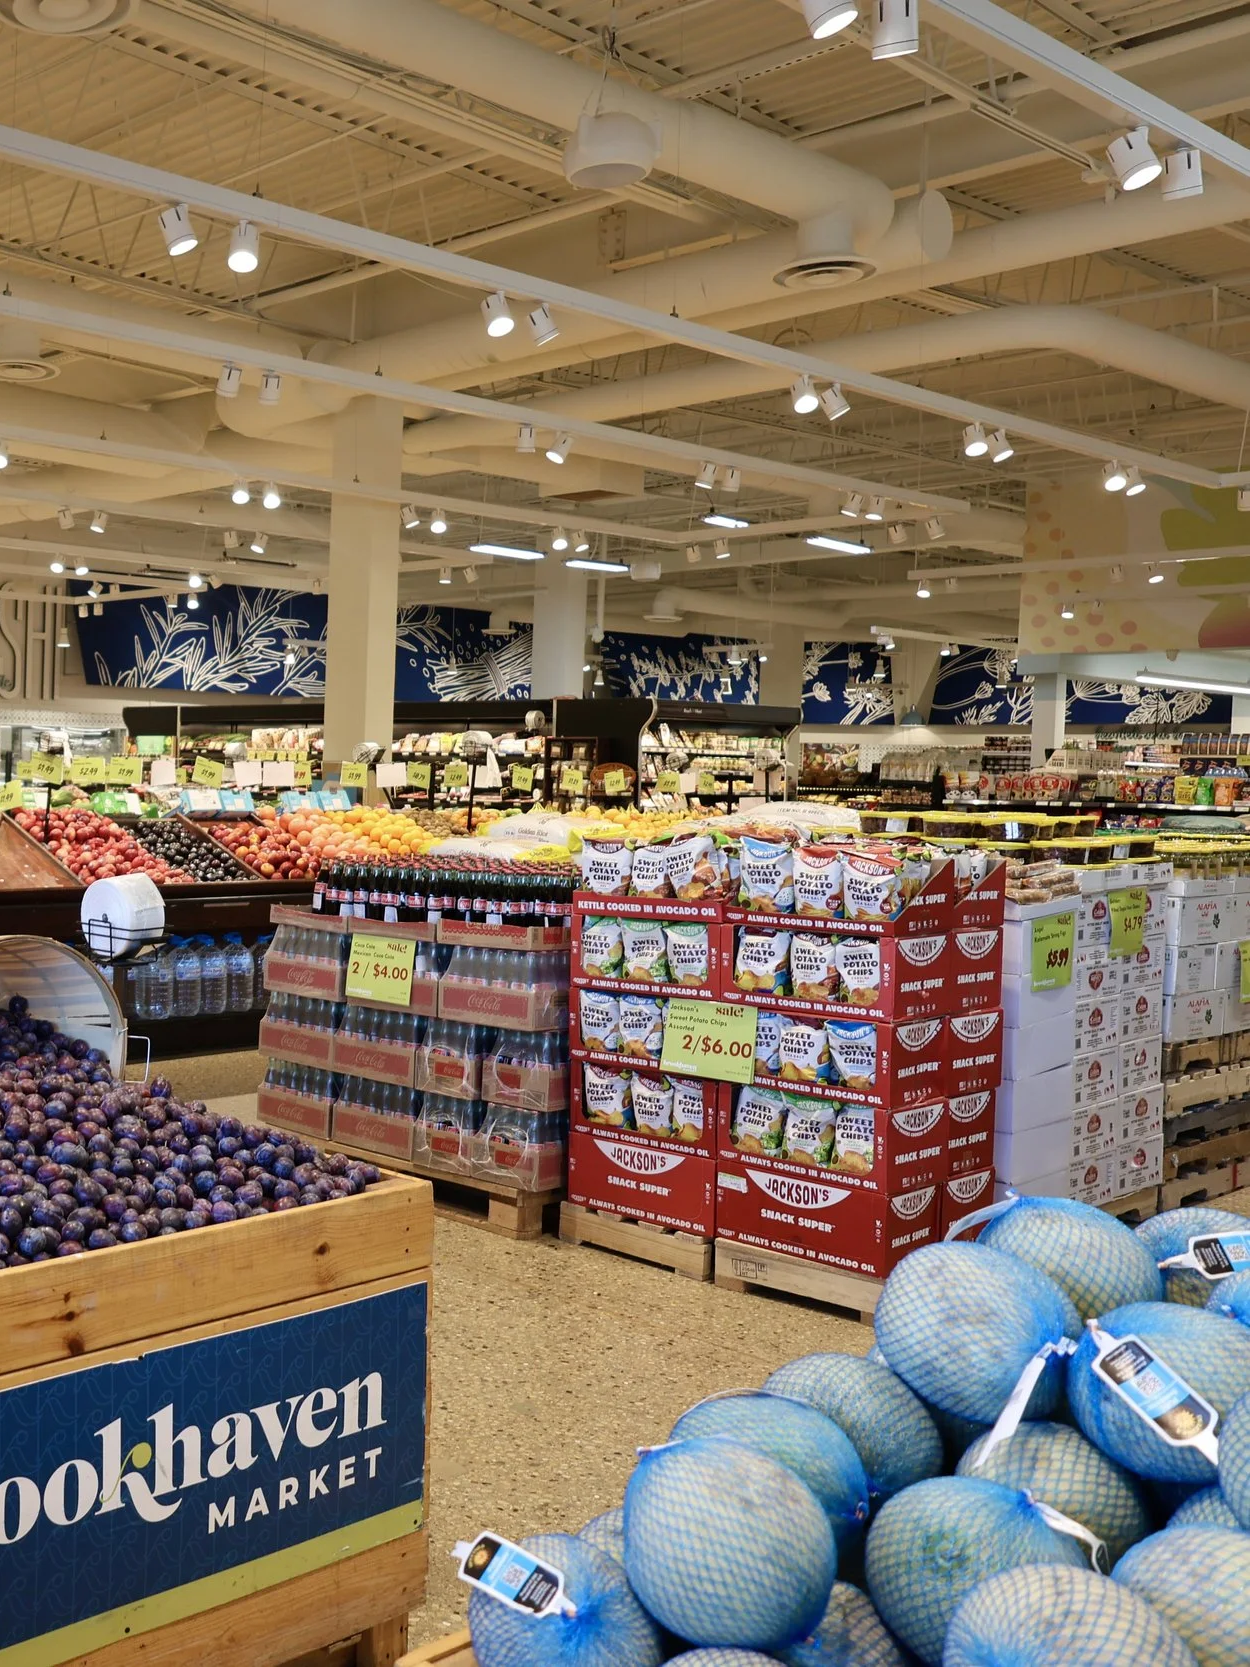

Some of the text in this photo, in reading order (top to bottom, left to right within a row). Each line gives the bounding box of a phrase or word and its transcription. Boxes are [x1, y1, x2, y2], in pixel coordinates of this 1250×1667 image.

[592, 860, 618, 868] SWEET
[666, 852, 692, 864] SWEET
[590, 867, 620, 876] POTATO
[852, 860, 890, 875] JACKSON'S
[795, 880, 833, 888] POTATO
[799, 872, 829, 881] SWEET
[799, 888, 826, 896] CHIPS
[578, 900, 716, 916] KETTLE COOKED IN AVOCADO OIL
[748, 915, 884, 932] ALWAYS COOKED IN AVOCADO OIL
[386, 943, 408, 954] sale!
[908, 940, 937, 958] JACKSON'S
[794, 955, 826, 964] POTATO
[352, 961, 360, 974] 2
[373, 962, 408, 980] $4.00
[900, 981, 922, 992] SNACK
[957, 974, 976, 984] SNACK
[592, 980, 619, 988] ALWAYS
[620, 982, 650, 992] COOKED
[662, 986, 698, 996] AVOCADO
[699, 990, 712, 998] OIL
[670, 1003, 698, 1013] Jackson's
[716, 1006, 744, 1018] sale!
[744, 995, 776, 1005] ALWAYS
[778, 998, 812, 1008] COOKED
[814, 1002, 824, 1010] IN
[826, 1004, 866, 1016] AVOCADO
[869, 1008, 884, 1018] OIL
[668, 1023, 695, 1032] Assorted
[689, 1016, 708, 1024] Potato
[710, 1018, 728, 1028] Chips
[682, 1034, 752, 1058] 2/$6.00
[590, 1052, 617, 1062] ALWAYS
[618, 1055, 648, 1066] COOKED
[650, 1060, 658, 1068] IN
[778, 1080, 810, 1092] COOKED
[812, 1086, 822, 1095] IN
[824, 1089, 866, 1102] AVOCADO
[868, 1094, 882, 1104] OIL
[592, 1128, 619, 1139] ALWAYS
[620, 1134, 648, 1144] COOKED
[660, 1142, 696, 1154] AVOCADO
[697, 1148, 710, 1157] OIL
[610, 1146, 666, 1172] JACKSON'S
[607, 1175, 637, 1190] SNACK
[765, 1178, 830, 1205] JACKSON'S
[760, 1208, 795, 1224] SNACK
[208, 1447, 384, 1534] MARKET
